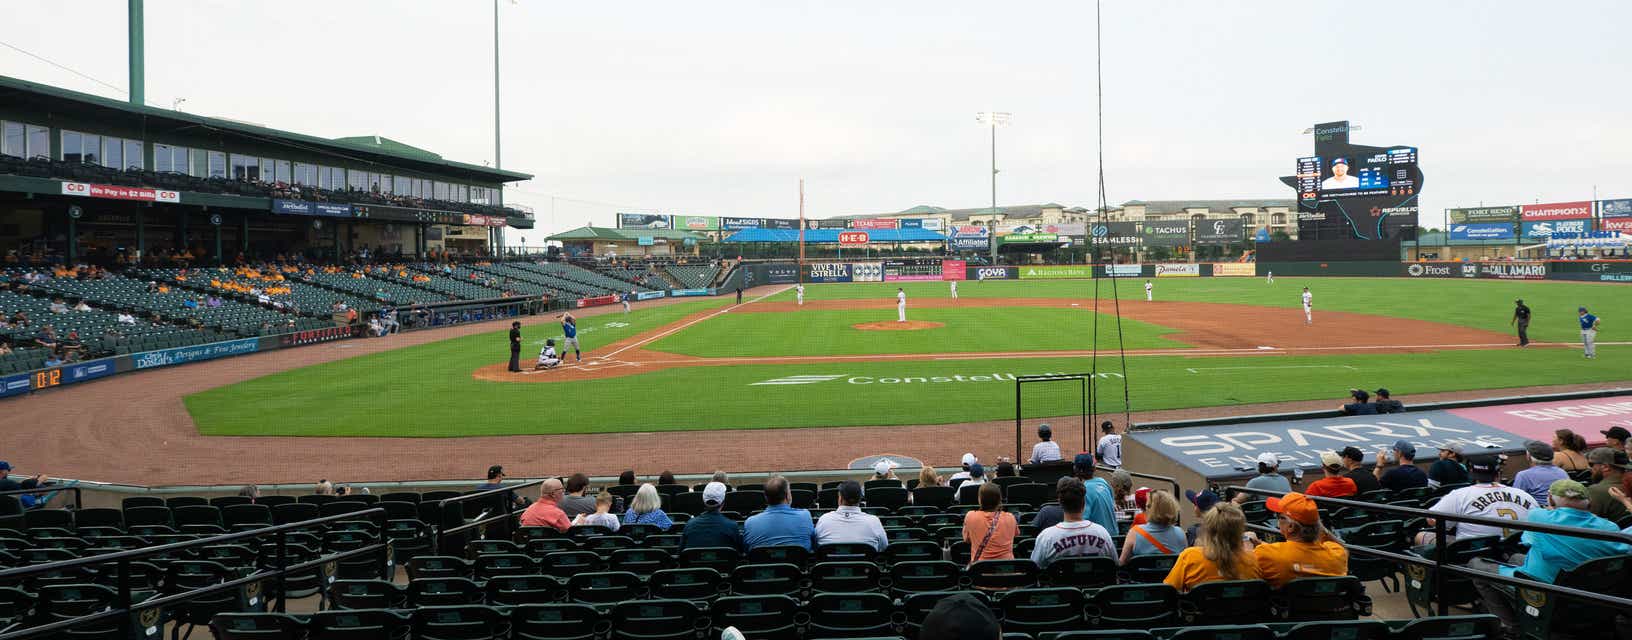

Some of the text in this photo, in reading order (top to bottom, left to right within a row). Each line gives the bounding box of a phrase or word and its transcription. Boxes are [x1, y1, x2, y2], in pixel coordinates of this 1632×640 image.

[104, 189, 118, 197] Pay
[1155, 226, 1187, 234] TACHUS
[1092, 236, 1137, 244] SEAMLESS
[812, 263, 831, 271] VIVE
[1424, 265, 1450, 275] Frost
[1490, 264, 1508, 275] CALL
[1510, 264, 1546, 275] AMARO
[810, 270, 848, 278] ESTRELLA
[978, 268, 1006, 279] GOYA
[137, 352, 173, 369] Dostal's
[848, 372, 1124, 385] Constelln
[1160, 418, 1473, 456] SPARX
[1472, 491, 1532, 512] BREGMAN
[1053, 534, 1106, 553] ALTUVE
